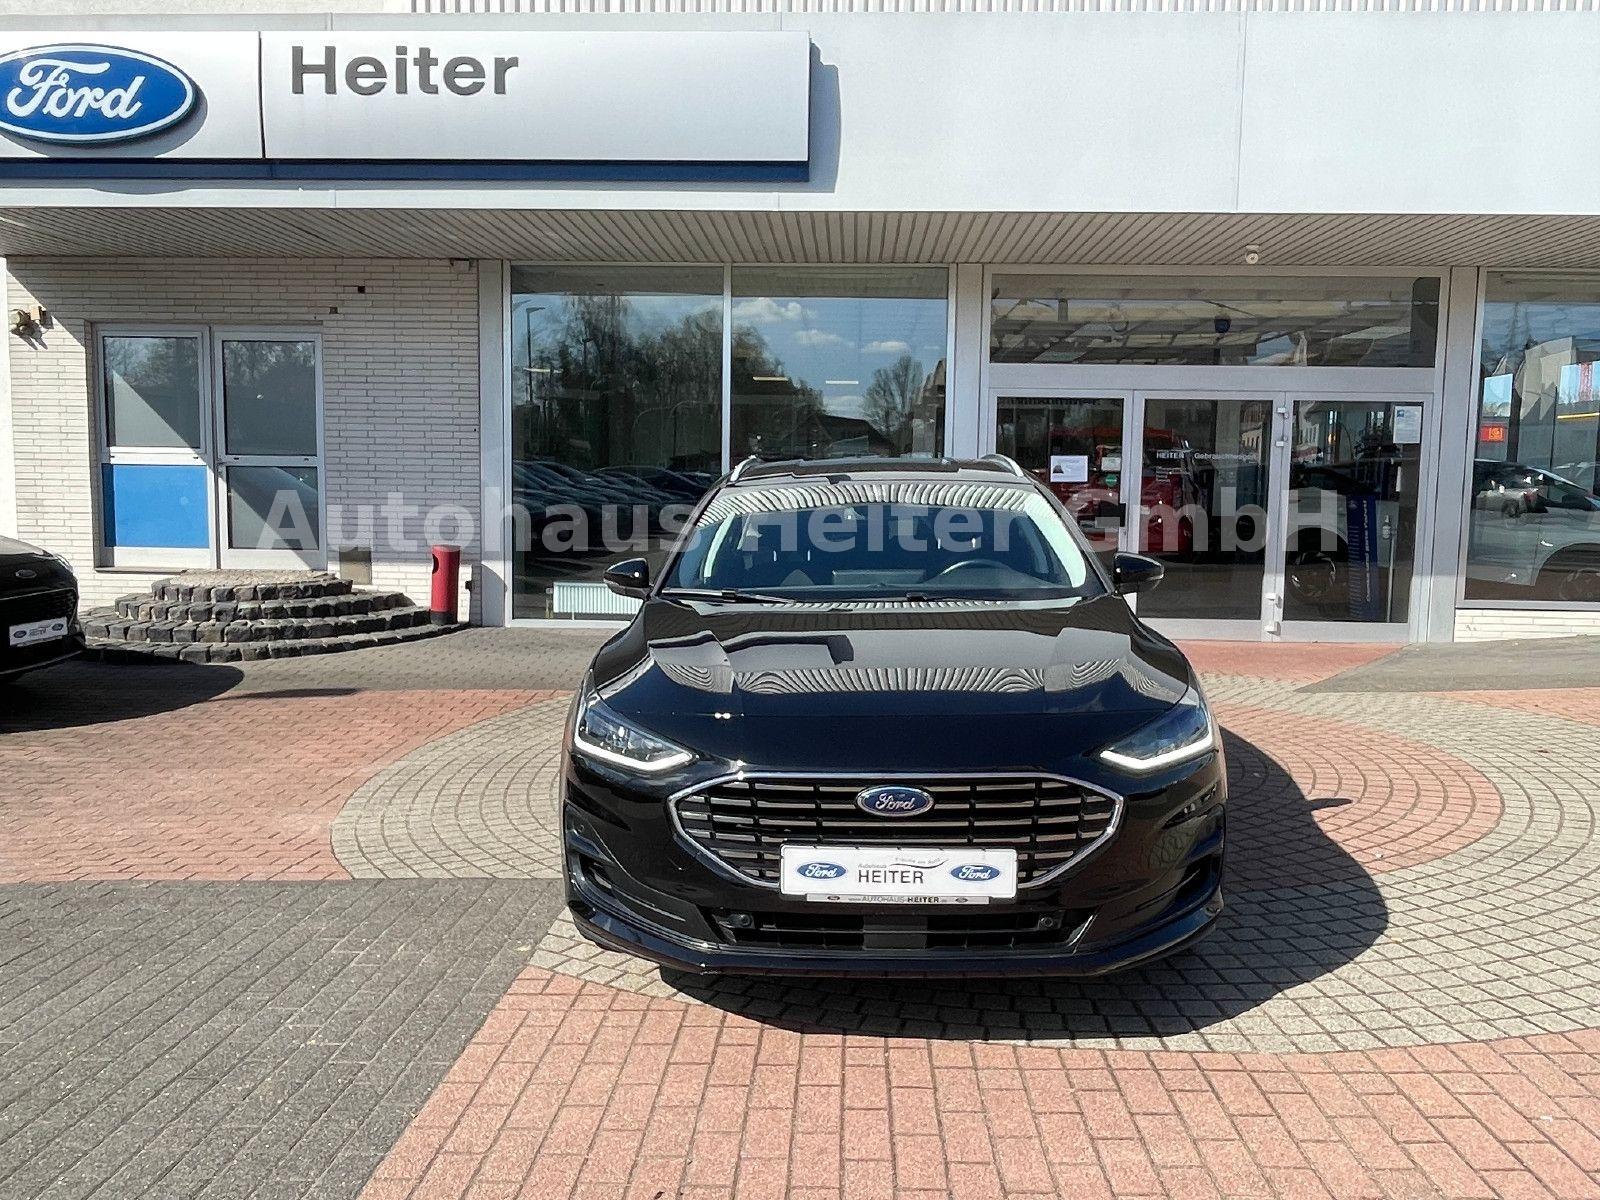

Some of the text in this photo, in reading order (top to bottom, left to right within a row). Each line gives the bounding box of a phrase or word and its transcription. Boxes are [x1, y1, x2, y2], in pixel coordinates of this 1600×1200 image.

[290, 45, 520, 96] Heiter
[6, 59, 145, 119] Ford
[875, 792, 916, 810] Ford
[804, 862, 838, 878] Ford
[858, 870, 924, 884] HEITER
[957, 865, 991, 880] Ford
